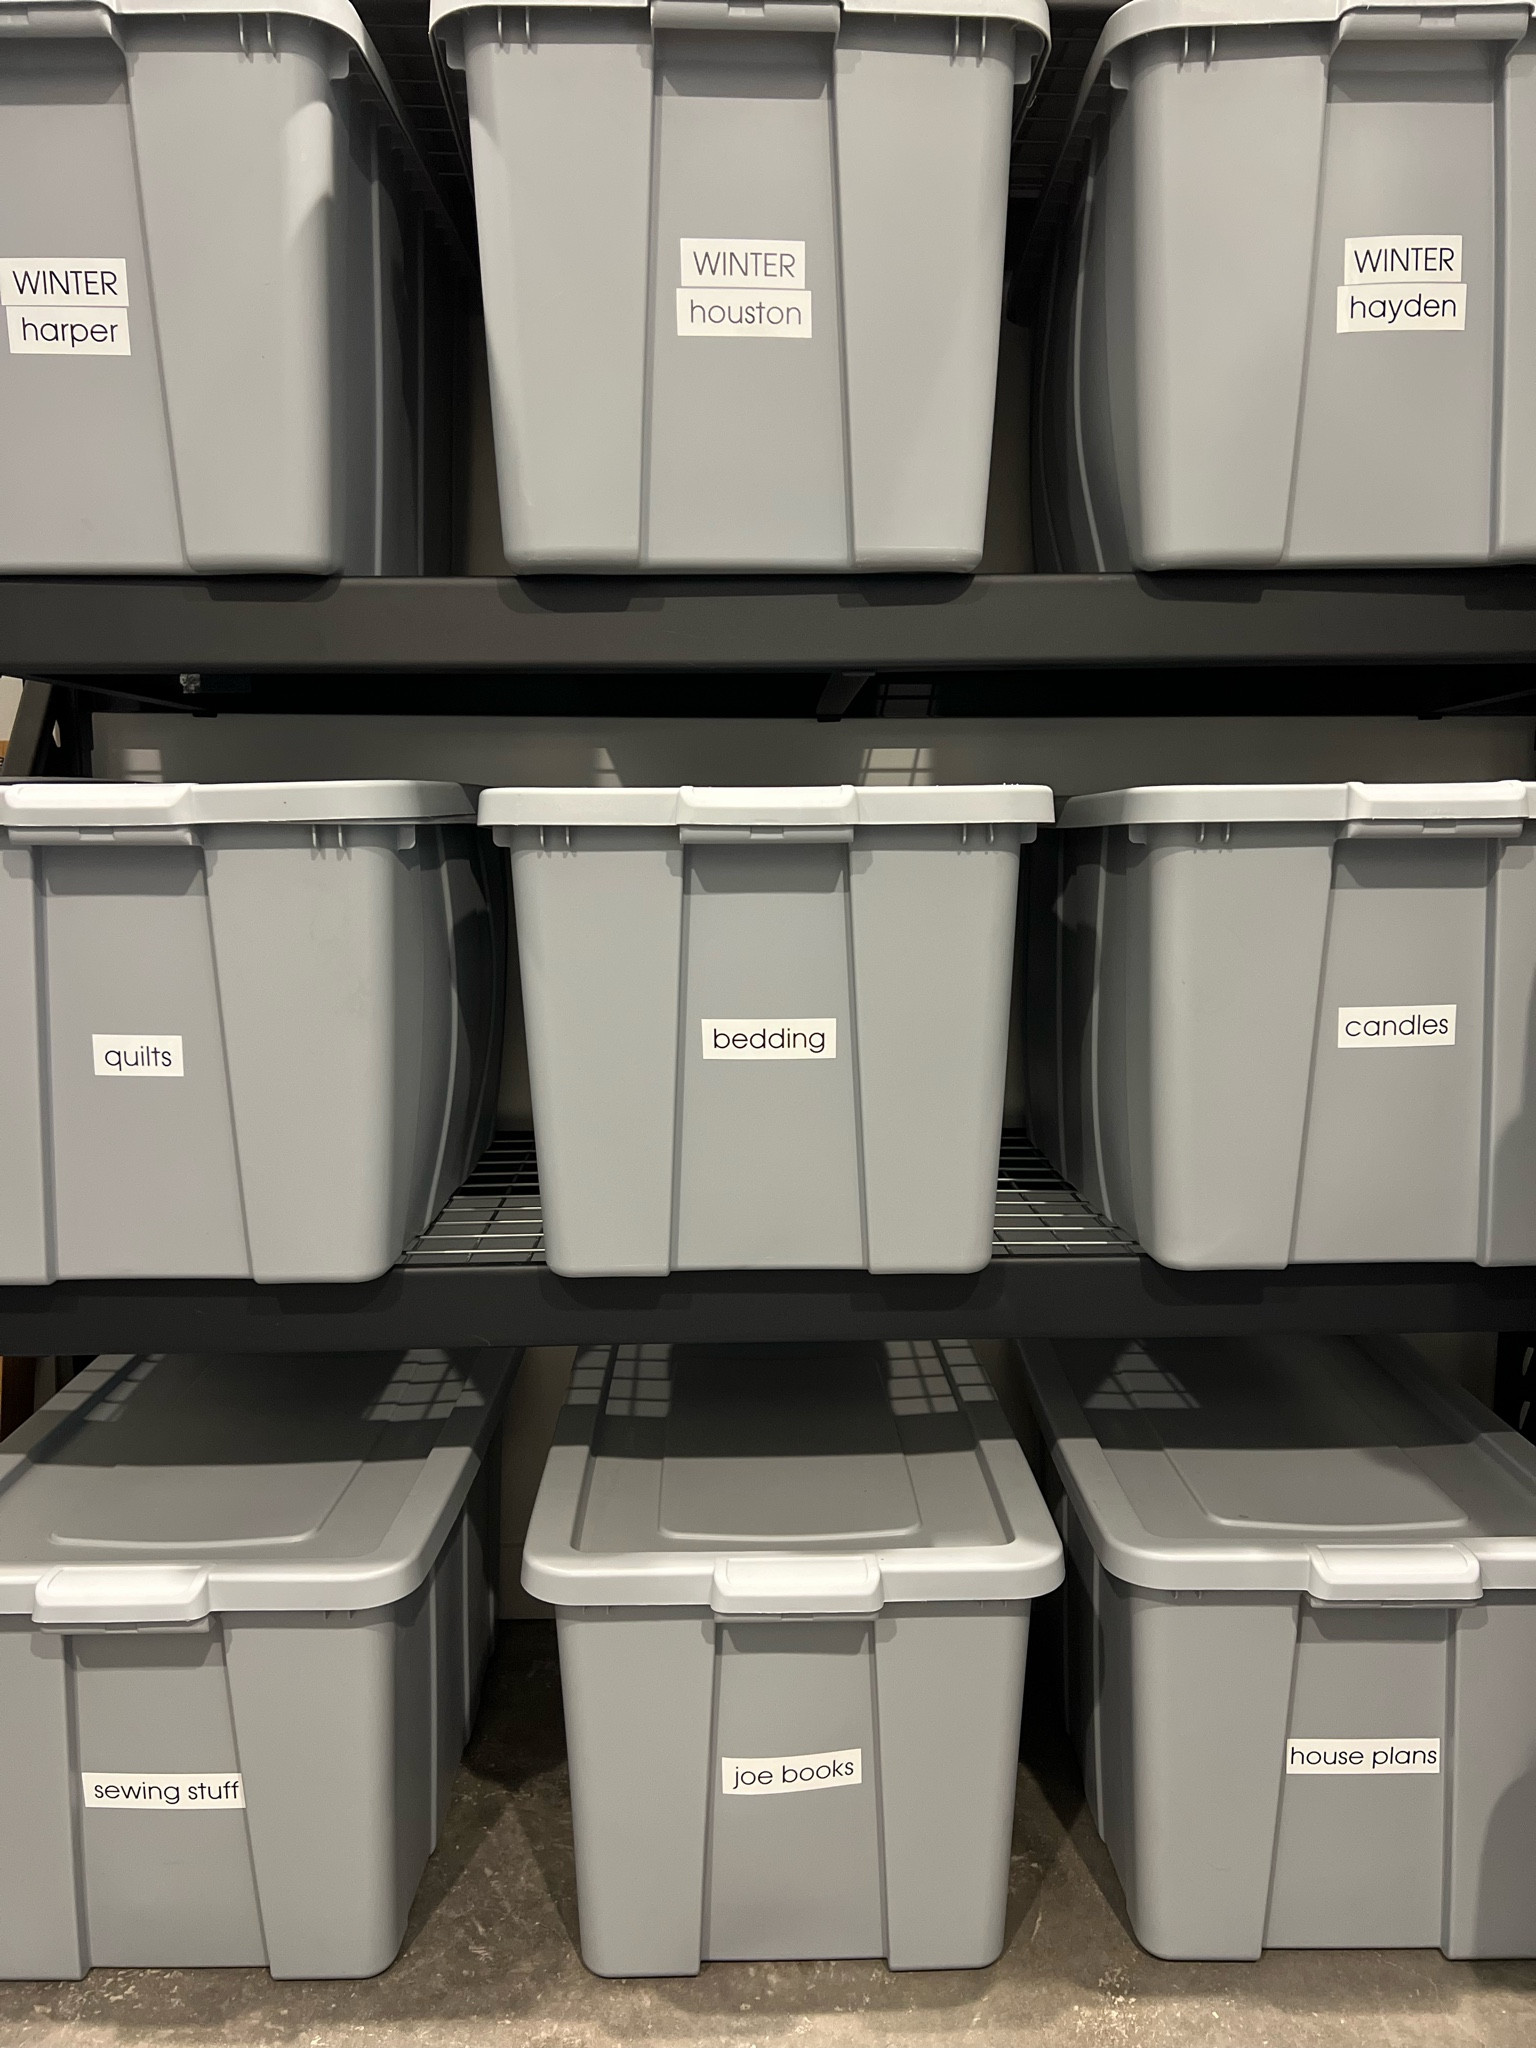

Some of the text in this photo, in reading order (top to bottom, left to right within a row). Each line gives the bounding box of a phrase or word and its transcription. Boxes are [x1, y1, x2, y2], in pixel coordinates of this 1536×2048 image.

[692, 250, 796, 278] WINTER
[1353, 247, 1455, 274] WINTER
[12, 270, 118, 296] WINTER
[690, 299, 802, 325] houston
[1350, 293, 1457, 324] hayden
[21, 316, 119, 348] harper
[1345, 1014, 1449, 1037] candles
[713, 1027, 825, 1054] bedding
[104, 1045, 172, 1072] quilts
[1290, 1746, 1437, 1770] house plans
[732, 1758, 854, 1790] joe books
[94, 1780, 240, 1805] sewing stuff
